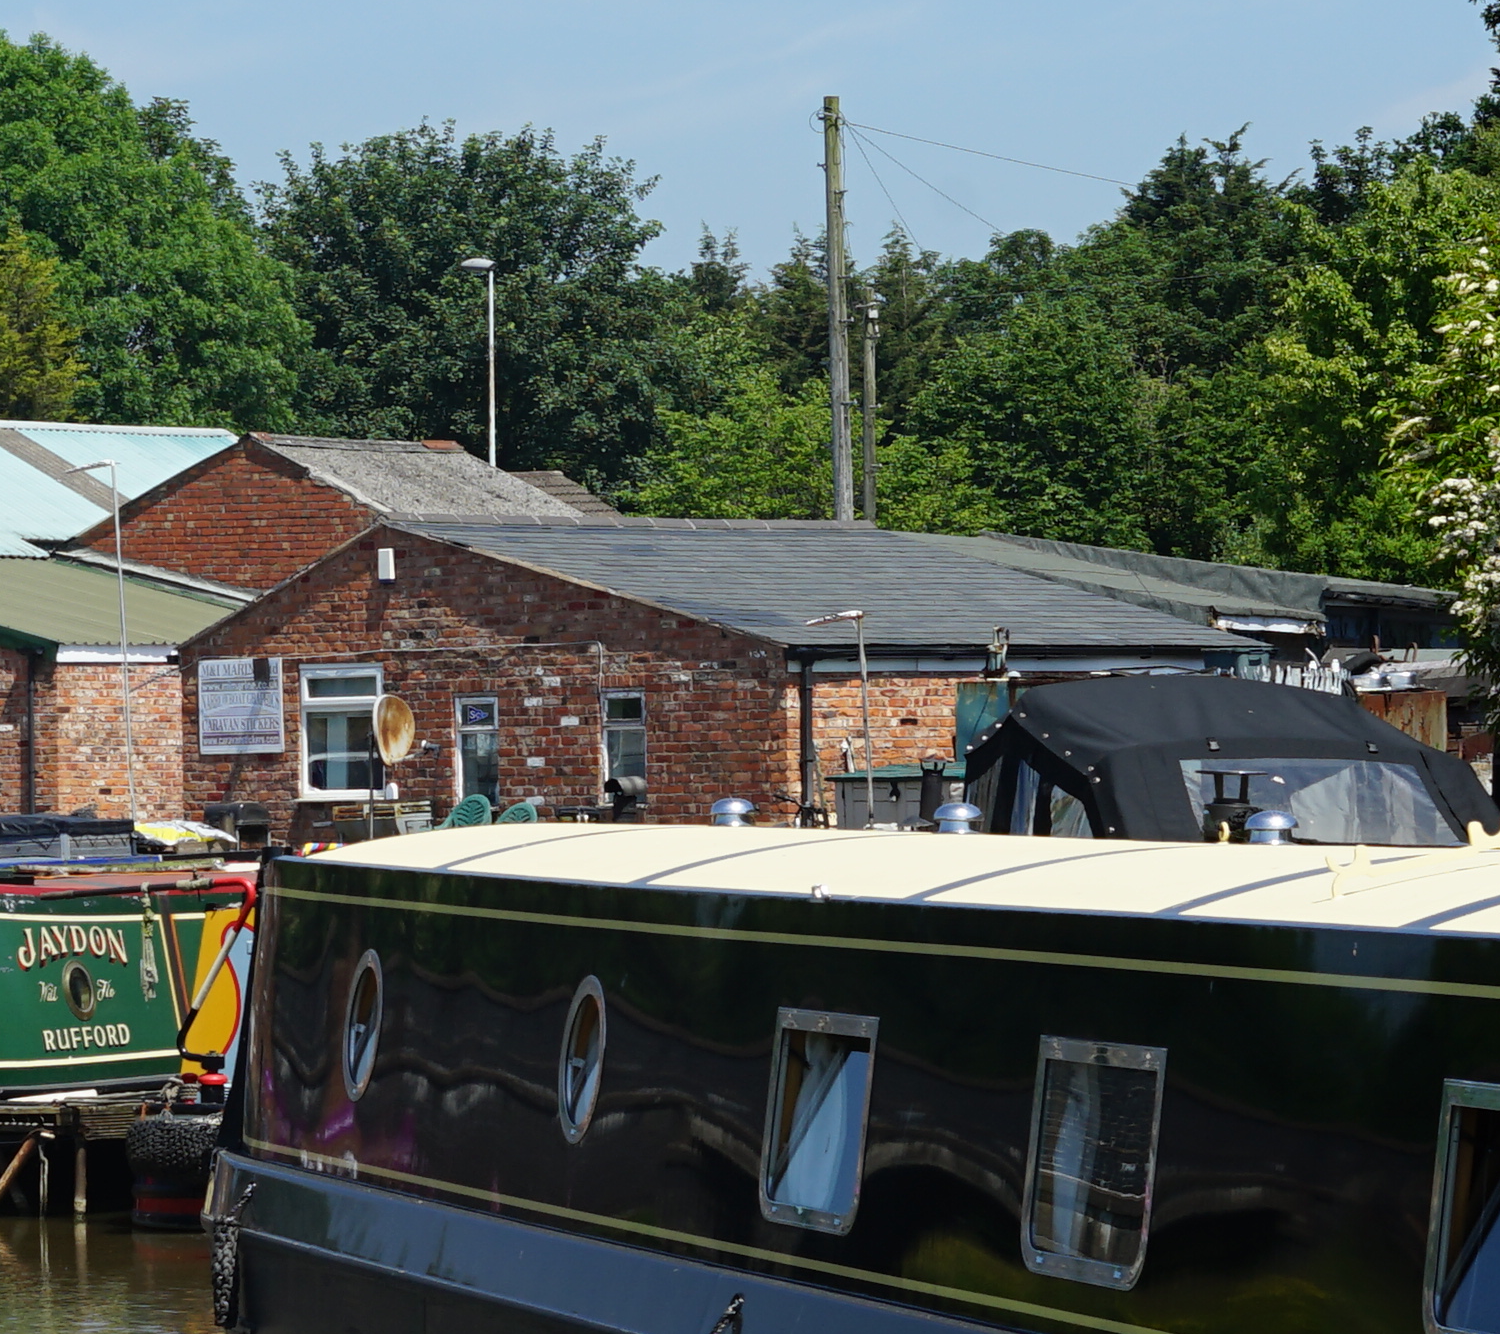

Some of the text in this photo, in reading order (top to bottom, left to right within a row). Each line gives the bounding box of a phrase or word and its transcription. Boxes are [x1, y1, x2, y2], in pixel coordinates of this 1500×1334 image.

[224, 663, 255, 676] MARIN
[202, 718, 279, 731] CARAVAN STICKERS
[17, 925, 128, 971] JAYDON
[42, 1023, 131, 1053] RUFFORD
